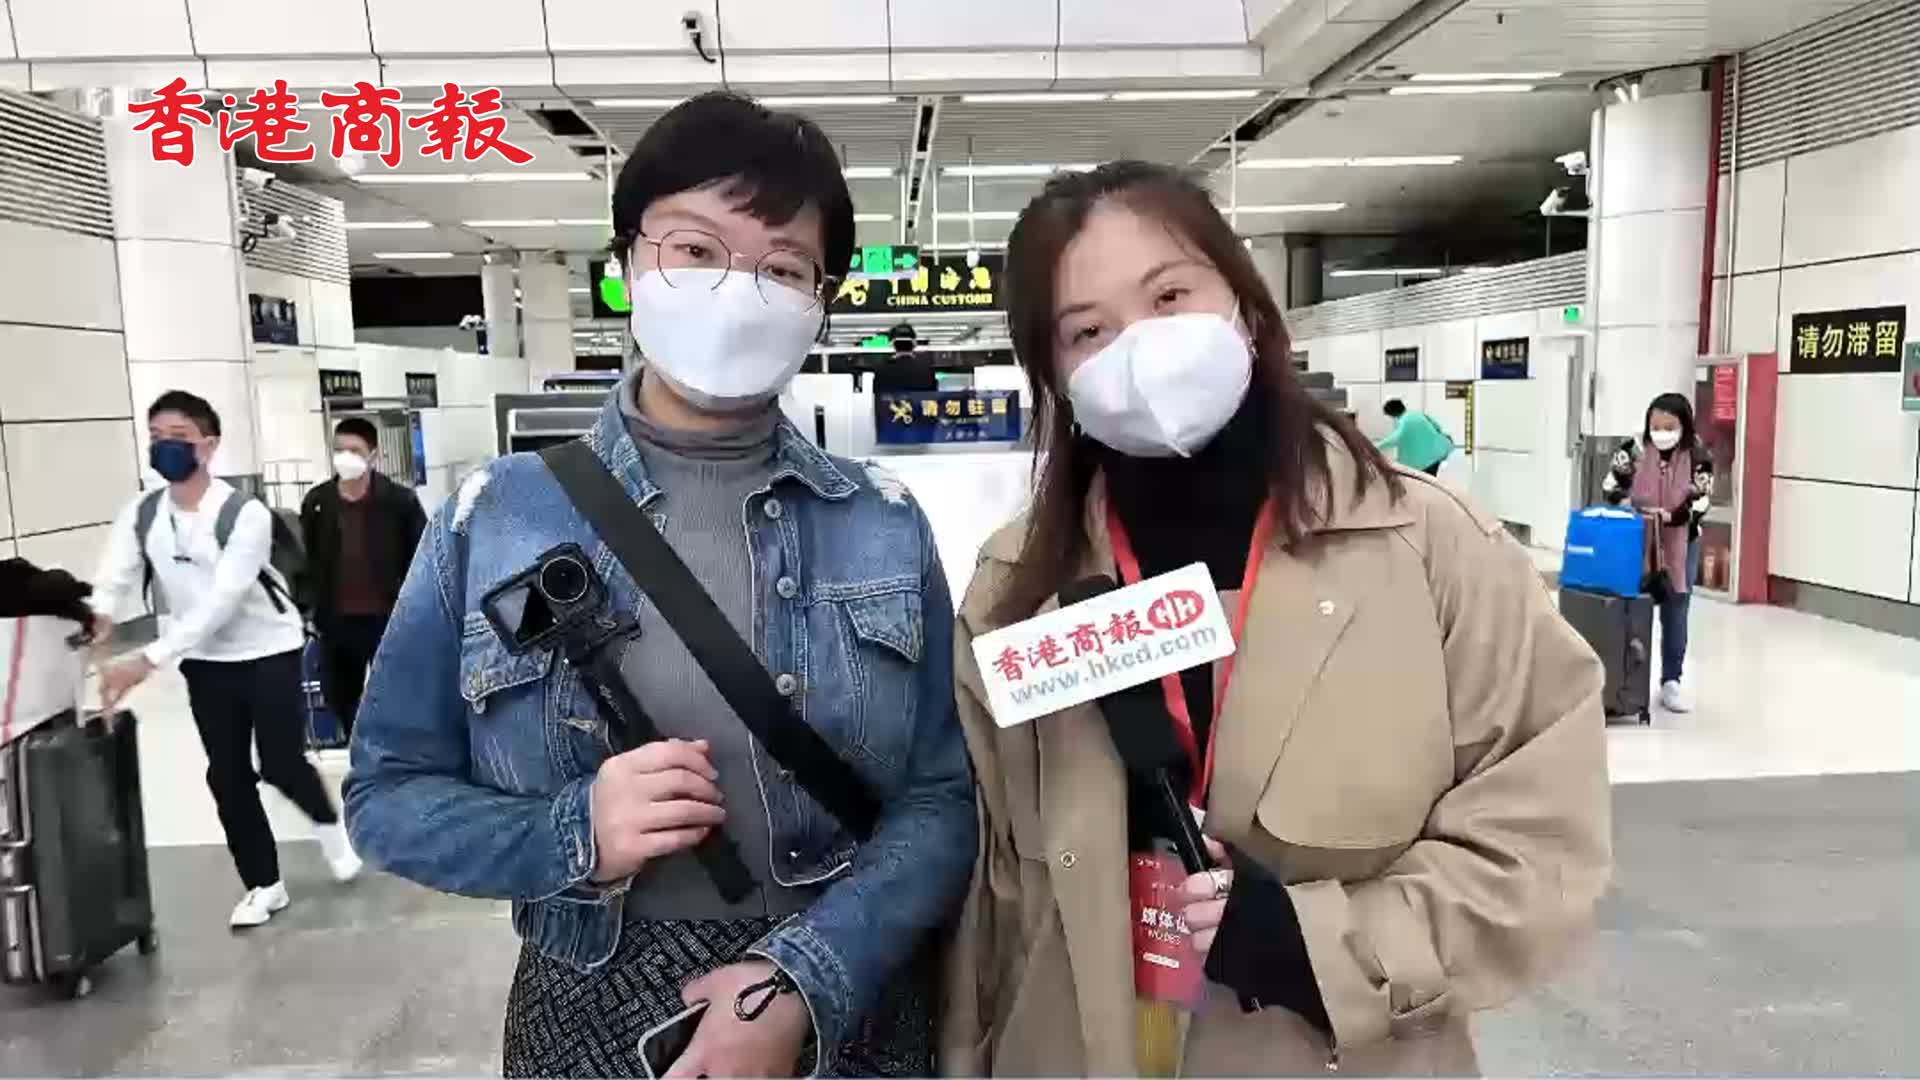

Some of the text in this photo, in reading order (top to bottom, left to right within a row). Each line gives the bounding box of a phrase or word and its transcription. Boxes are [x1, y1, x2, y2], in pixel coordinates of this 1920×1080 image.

[887, 295, 928, 306] CHINA
[1797, 320, 1899, 359] 请勿滞留
[992, 609, 1155, 683] 香港商報
[1009, 626, 1217, 706] www.hkcd.com
